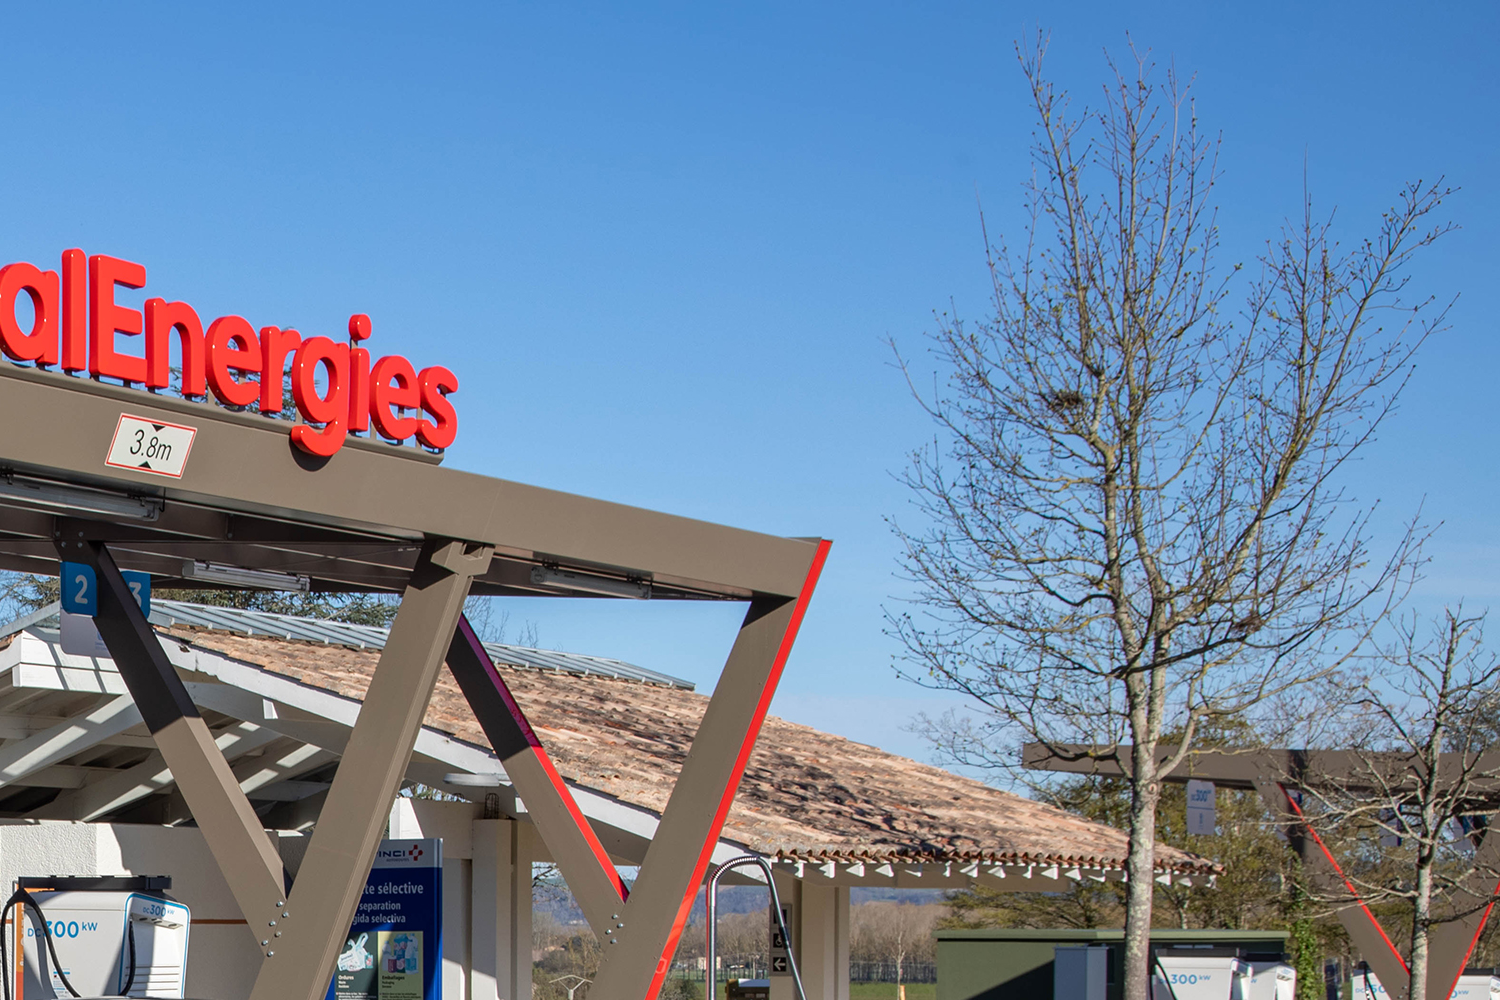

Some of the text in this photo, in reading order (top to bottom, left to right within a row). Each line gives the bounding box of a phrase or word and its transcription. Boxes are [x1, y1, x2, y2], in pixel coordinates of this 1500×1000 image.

[130, 429, 172, 461] 3.8m
[74, 574, 88, 605] 2
[128, 581, 142, 608] 3
[376, 850, 406, 858] INCI
[377, 882, 424, 895] sélective
[150, 904, 166, 917] 300
[359, 900, 401, 913] separation
[352, 913, 406, 926] gida selectiva
[81, 922, 98, 932] kW
[1170, 974, 1198, 985] 300
